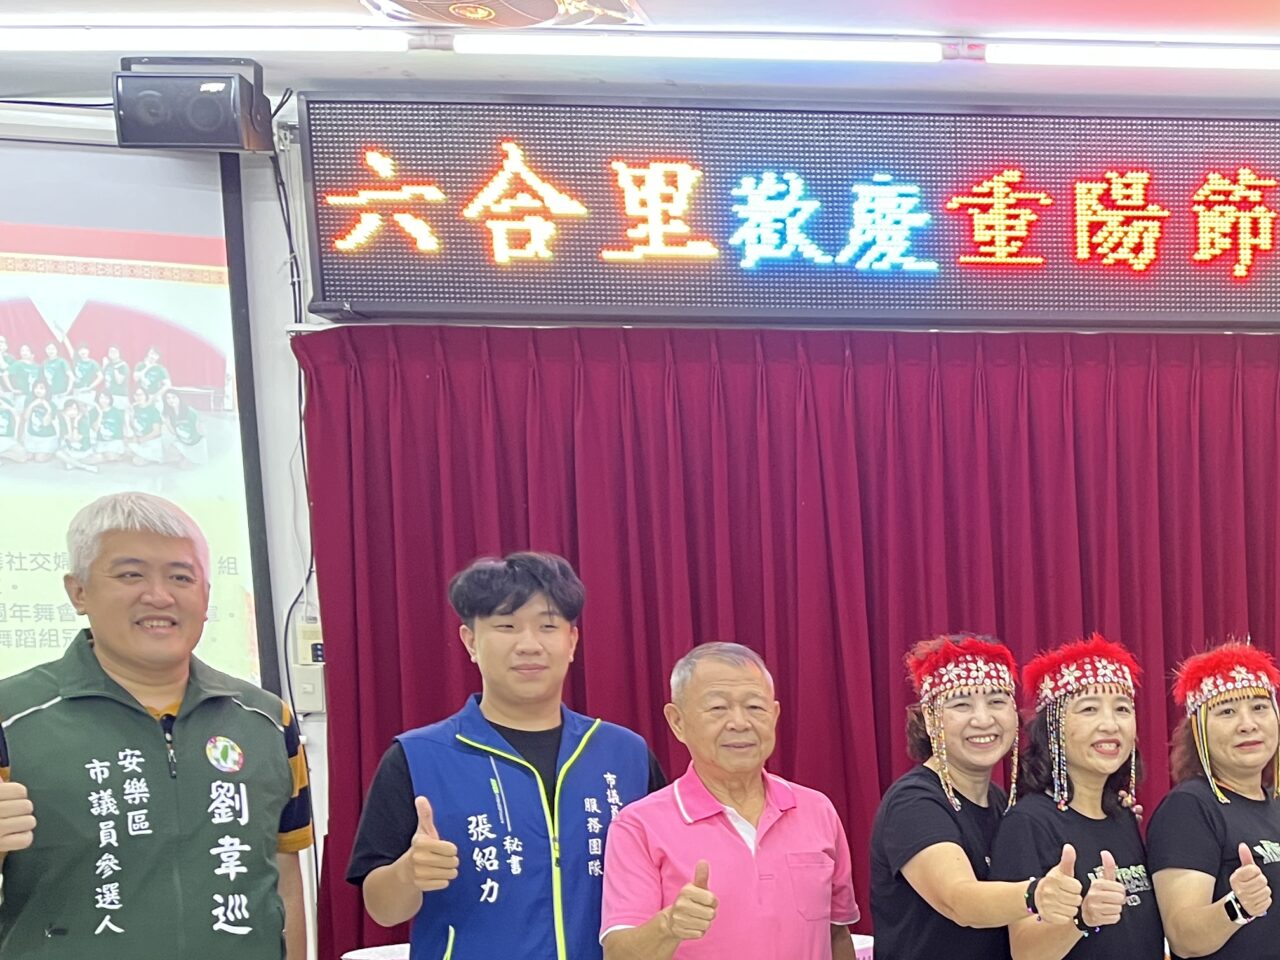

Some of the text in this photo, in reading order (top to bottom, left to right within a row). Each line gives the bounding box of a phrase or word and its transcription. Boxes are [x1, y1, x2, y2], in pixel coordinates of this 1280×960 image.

[117, 748, 153, 836] 安樂區
[584, 797, 604, 876] 服務團隊
[85, 758, 125, 935] 市議員參選人
[207, 780, 252, 935] 劉韋巡
[467, 813, 499, 903] 張紹力
